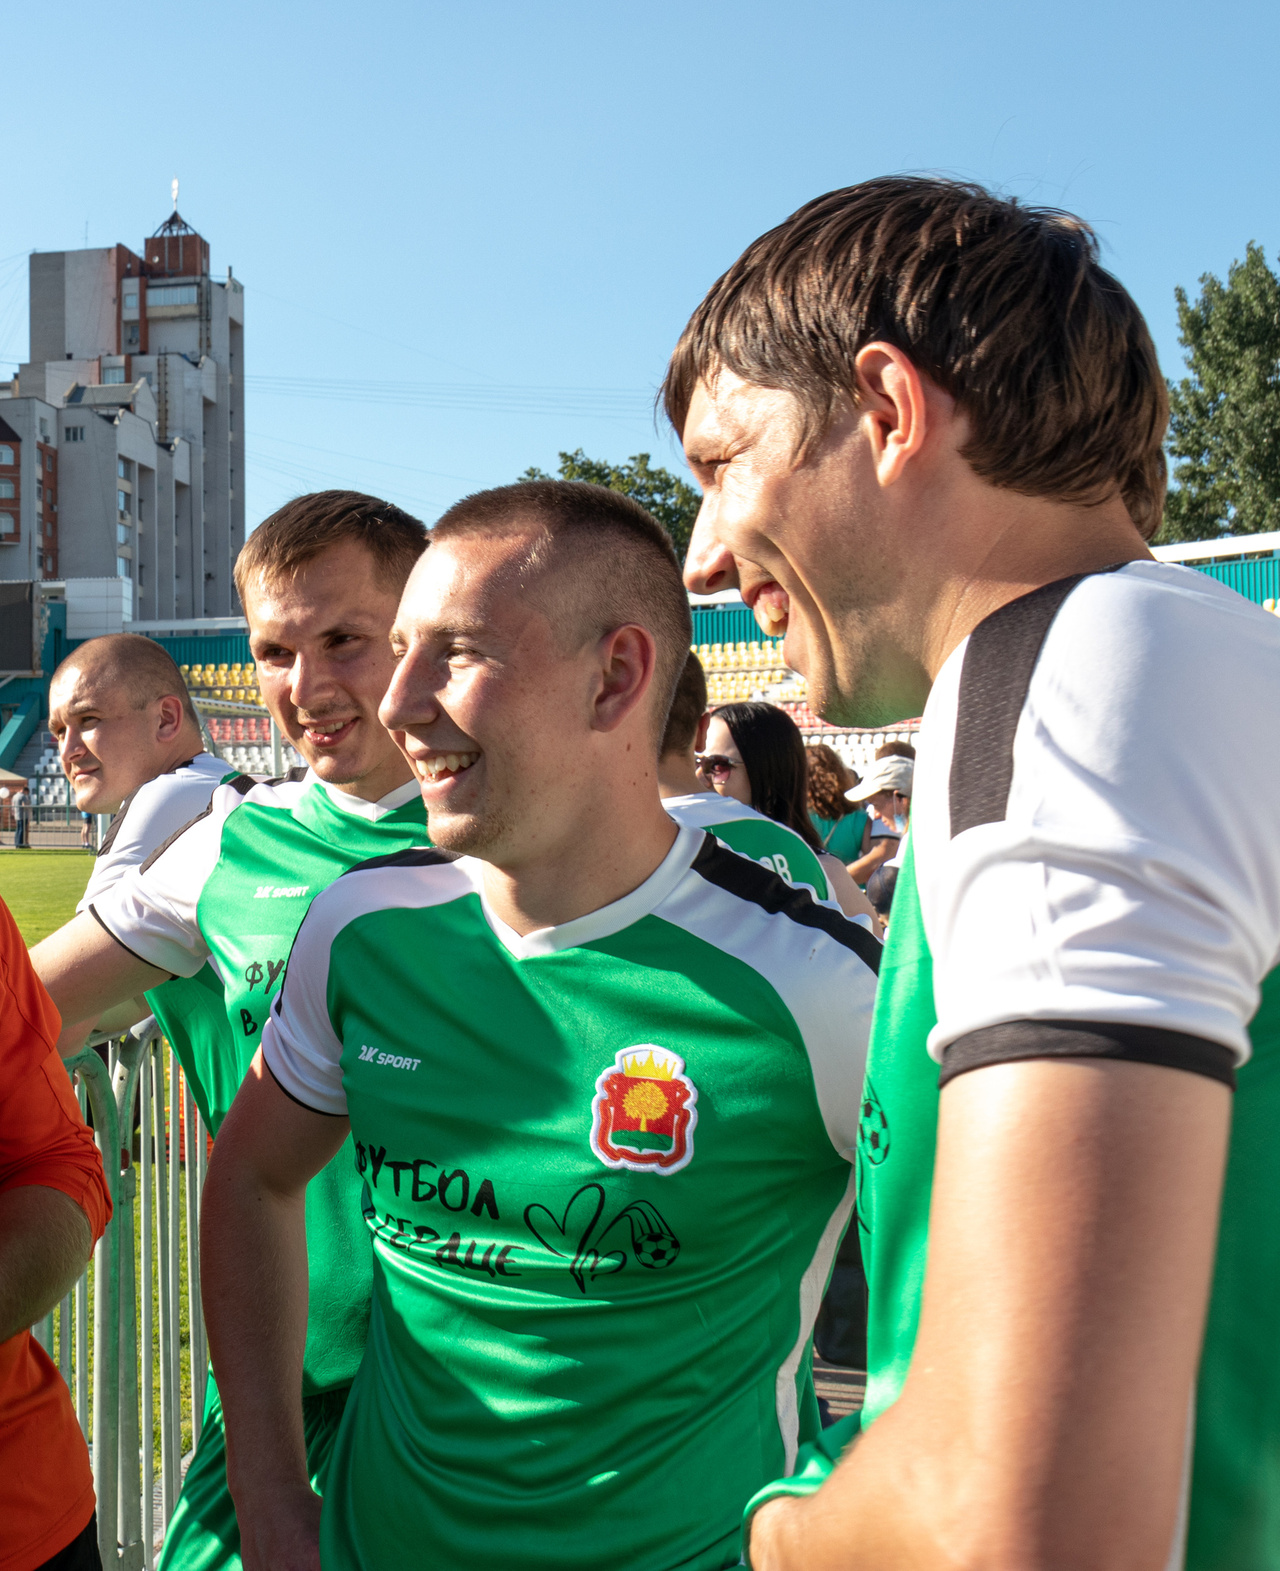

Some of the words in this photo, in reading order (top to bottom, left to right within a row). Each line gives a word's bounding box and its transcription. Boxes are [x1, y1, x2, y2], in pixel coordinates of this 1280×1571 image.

[271, 886, 310, 898] SPORT
[376, 1052, 422, 1071] SPORT
[355, 1140, 500, 1220] ФУТБОЛ
